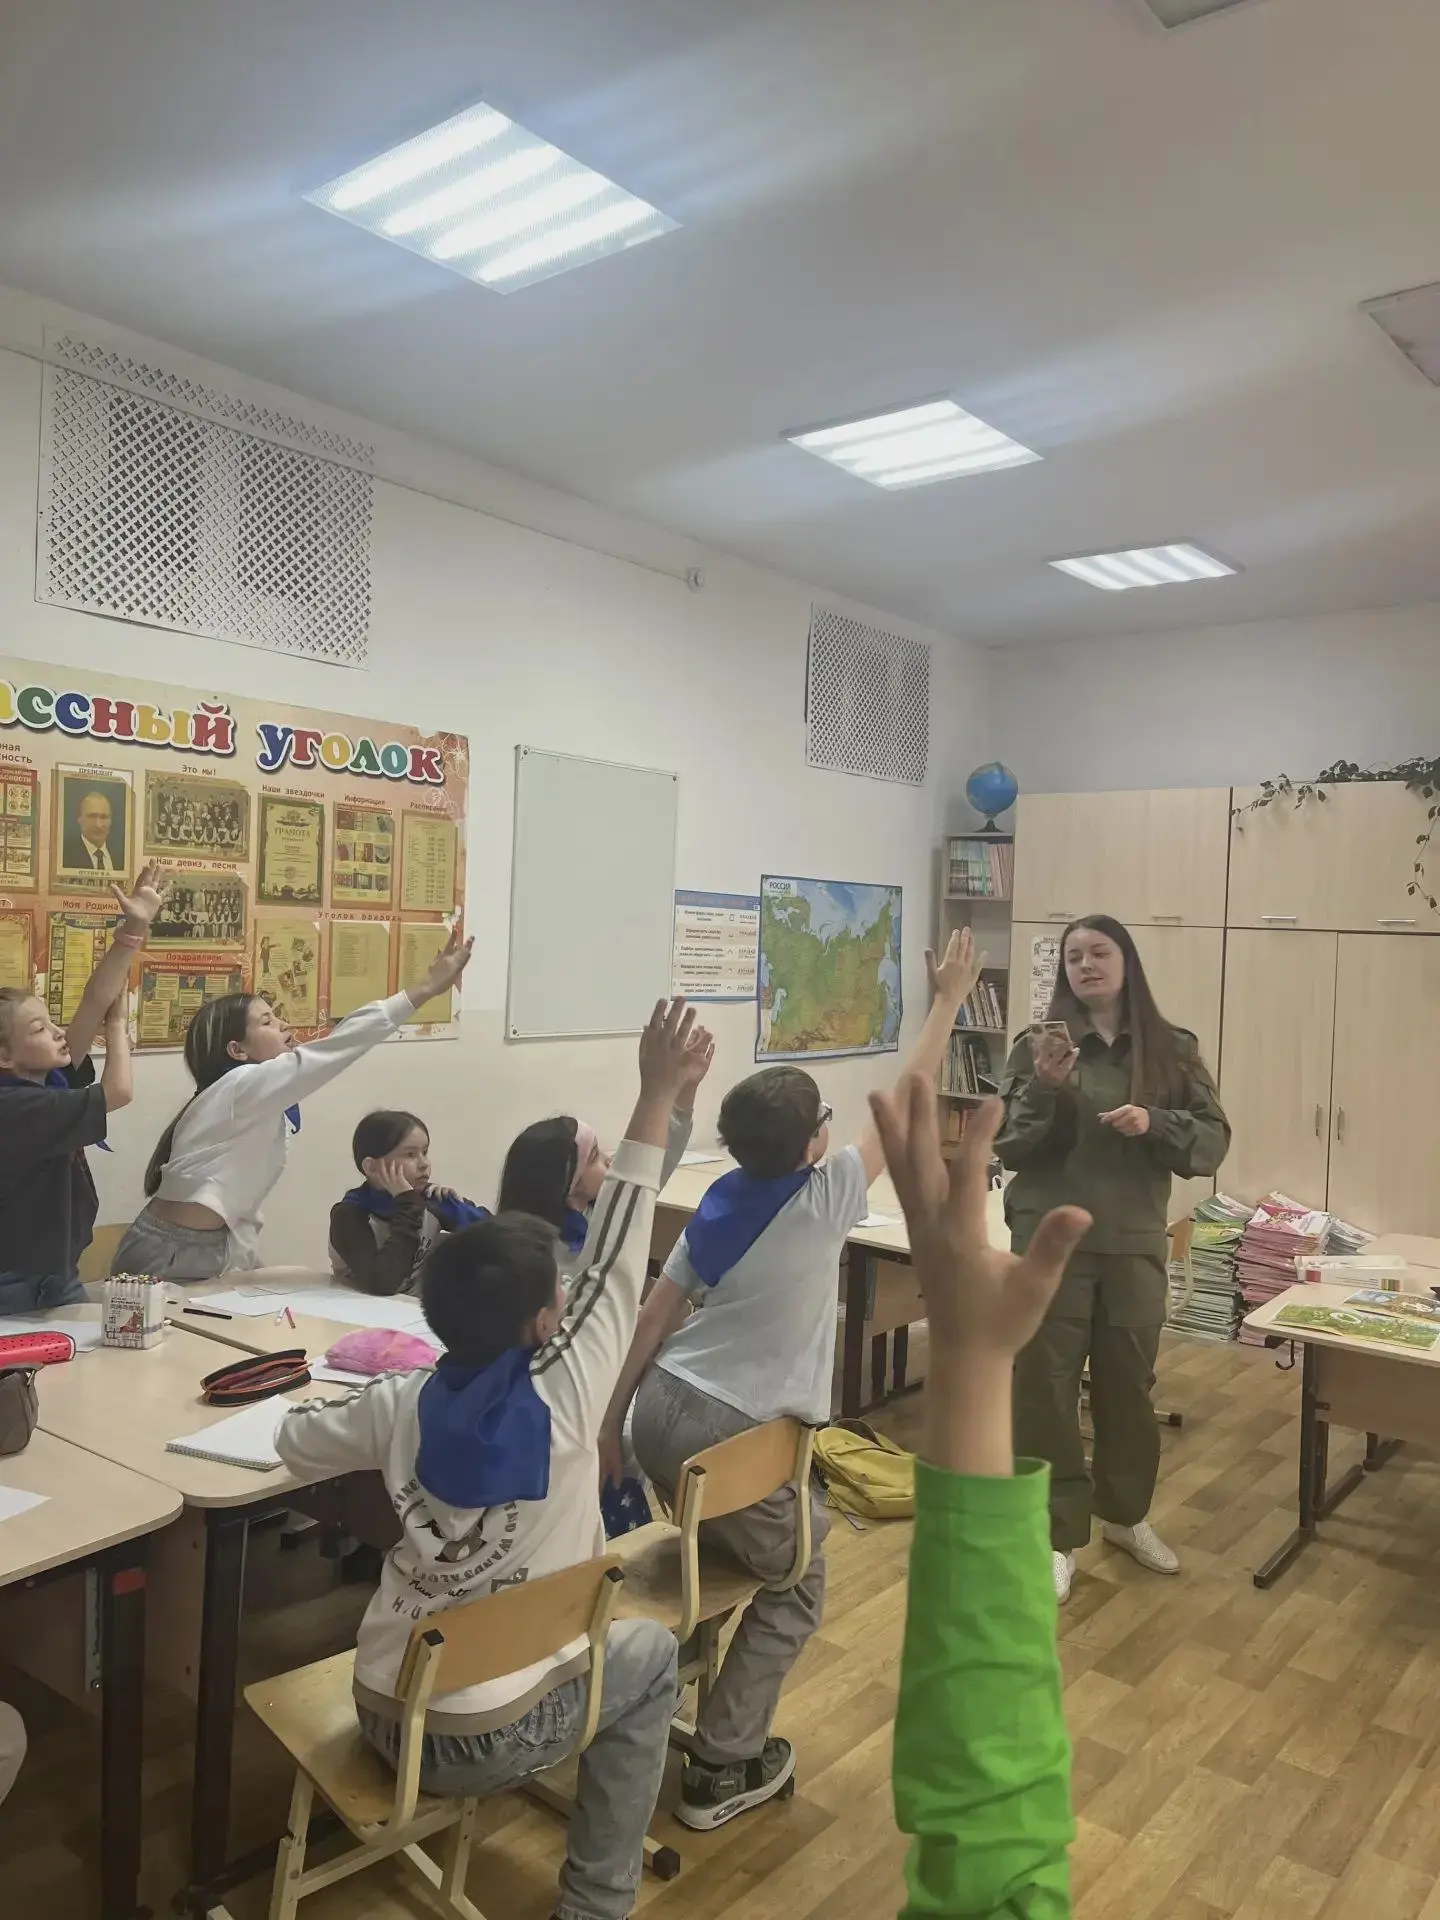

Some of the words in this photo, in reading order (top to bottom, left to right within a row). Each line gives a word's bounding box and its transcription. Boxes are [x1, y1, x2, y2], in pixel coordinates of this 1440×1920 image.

[257, 722, 444, 783] уголок
[262, 783, 281, 793] Наши
[212, 862, 237, 870] песня
[62, 900, 81, 909] Моя
[86, 901, 119, 911] Родина
